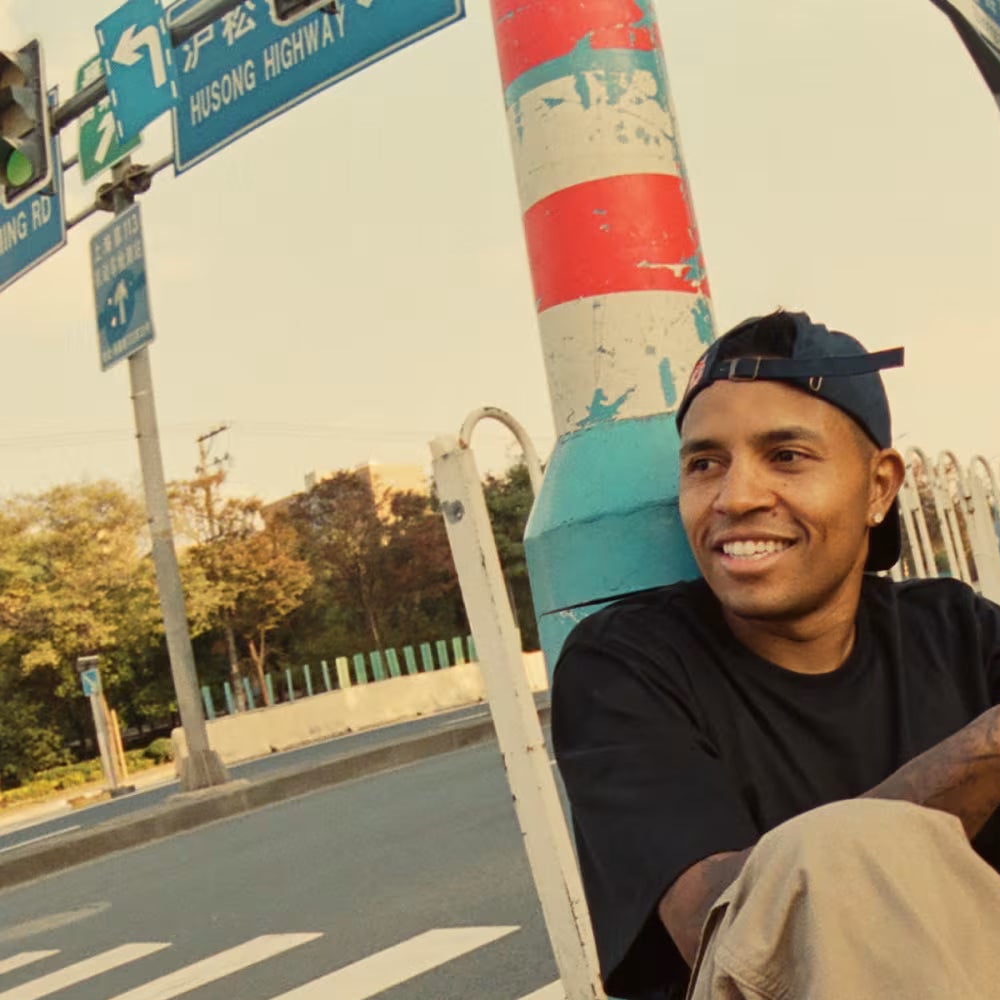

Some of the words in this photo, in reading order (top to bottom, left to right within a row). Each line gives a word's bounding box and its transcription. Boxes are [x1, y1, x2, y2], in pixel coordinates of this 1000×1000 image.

[189, 58, 256, 127] HUSONG
[263, 3, 345, 81] HIGHWAY
[31, 195, 52, 231] RD
